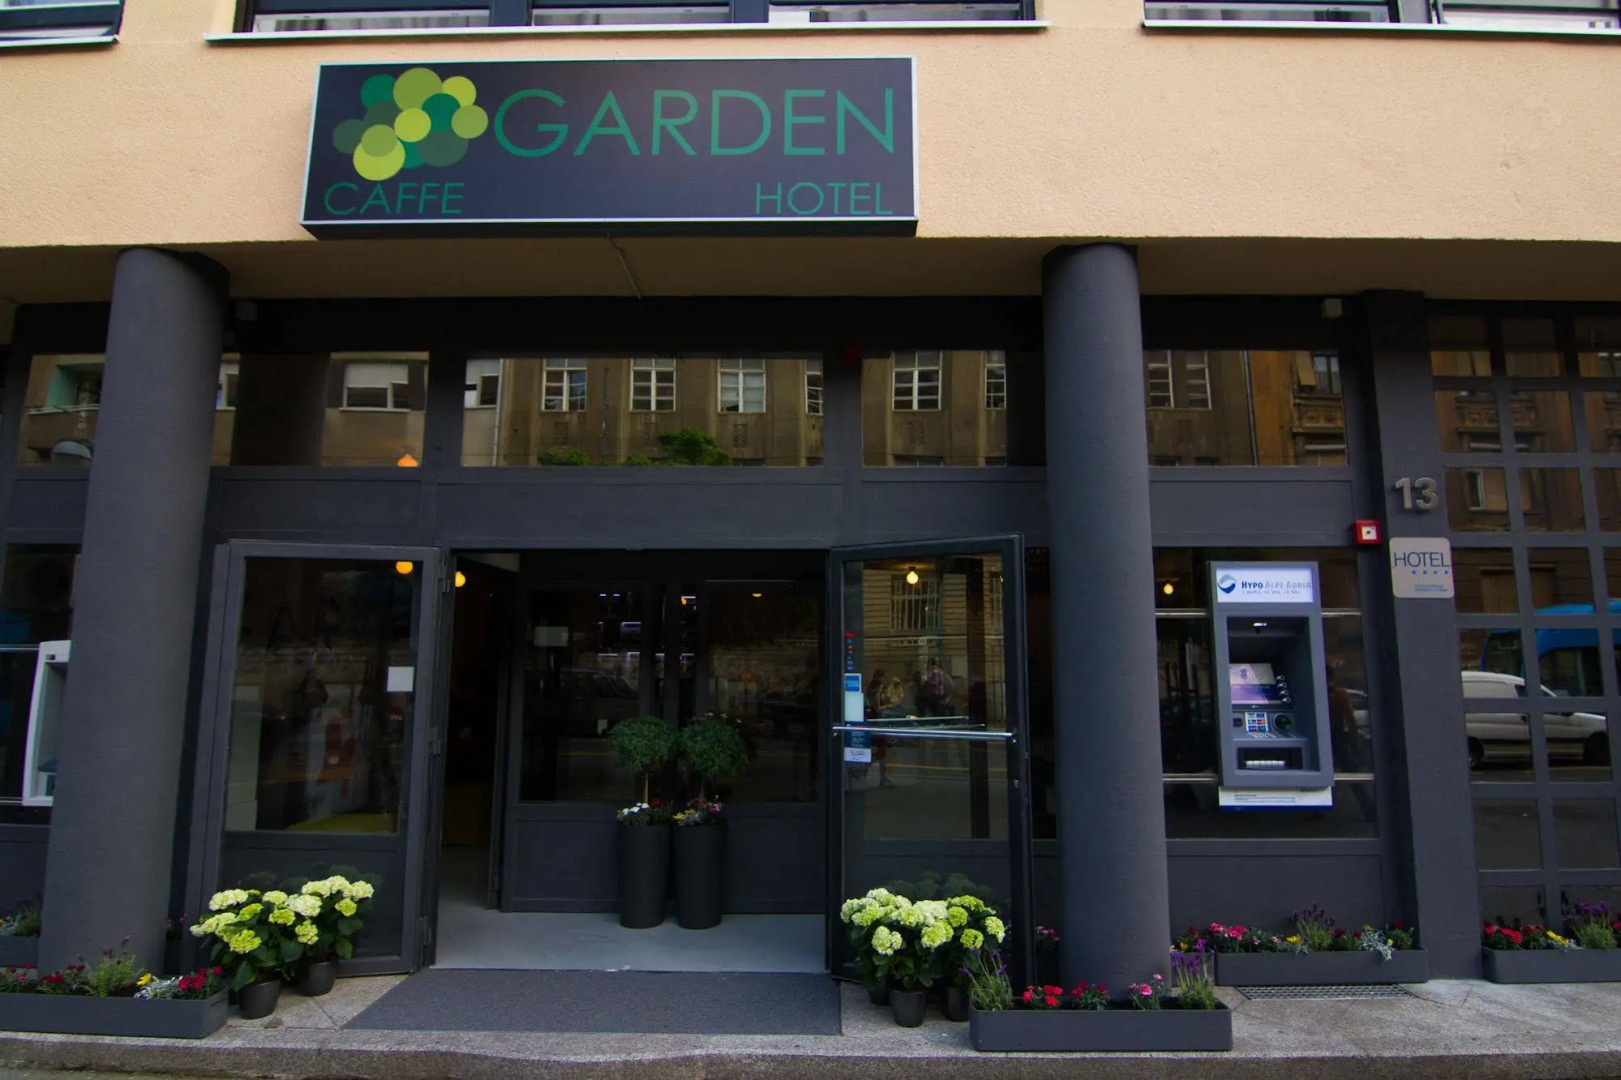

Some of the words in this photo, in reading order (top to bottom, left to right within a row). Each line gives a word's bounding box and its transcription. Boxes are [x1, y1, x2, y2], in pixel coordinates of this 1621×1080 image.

[494, 88, 894, 157] GARDEN
[324, 182, 465, 214] CAFFE
[755, 182, 893, 215] HOTEL
[1395, 477, 1439, 510] 13
[1394, 552, 1451, 567] HOTEL
[1241, 581, 1263, 589] HYPO
